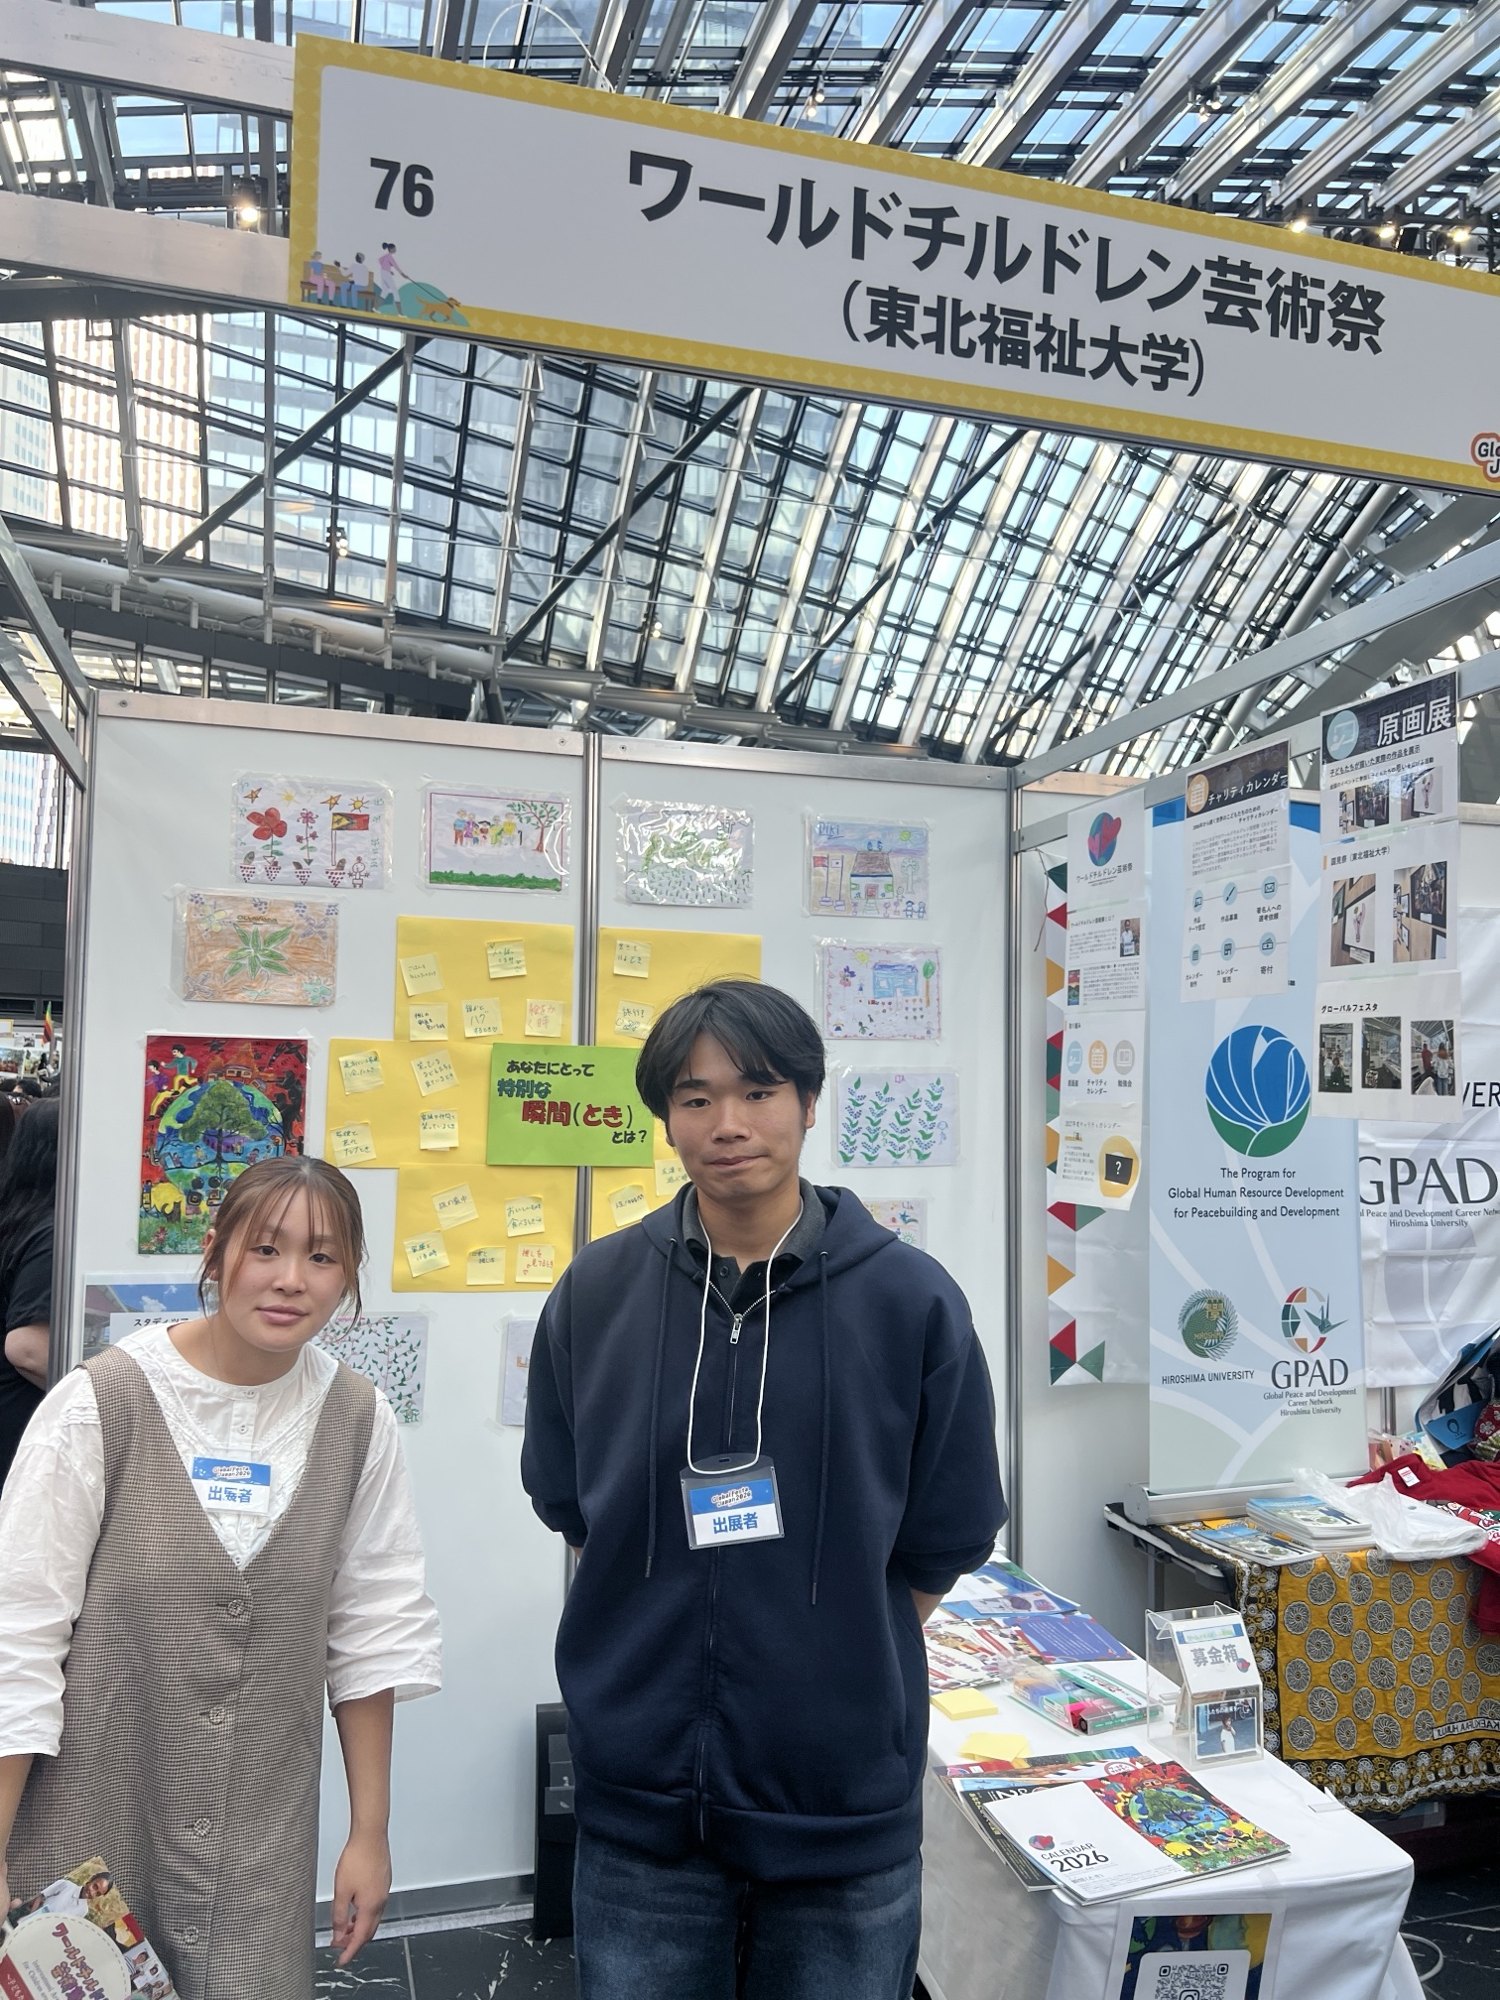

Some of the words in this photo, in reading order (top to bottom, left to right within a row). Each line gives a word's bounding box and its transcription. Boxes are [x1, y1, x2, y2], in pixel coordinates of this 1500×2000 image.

[370, 157, 434, 217] 76
[629, 150, 1386, 355] ワールドチルドレン芸術祭
[842, 280, 1204, 396] (東北福祉大学)
[1377, 696, 1452, 747] 原画展
[1208, 772, 1288, 805] チャリティカレンダー
[1216, 967, 1239, 976] カレンダー
[1260, 965, 1273, 975] 寄付
[1321, 1002, 1378, 1014] グローバルフェスタ
[506, 1059, 596, 1077] あなたにとって
[497, 1078, 552, 1099] 特別な
[522, 1100, 633, 1129] 瞬間(とき)
[611, 1129, 648, 1144] とは？
[1115, 1160, 1122, 1175] ?
[1220, 1167, 1239, 1178] The
[1241, 1167, 1280, 1181] Program
[1282, 1167, 1296, 1178] for
[1359, 1156, 1499, 1205] GPAD
[1168, 1187, 1201, 1199] Global
[1203, 1187, 1237, 1198] Human
[1239, 1186, 1283, 1198] Resource
[1285, 1186, 1344, 1200] Development
[1174, 1207, 1188, 1218] for
[1191, 1206, 1258, 1219] Peacebuilding
[1260, 1206, 1278, 1217] and
[1280, 1205, 1340, 1219] Development
[1366, 1209, 1387, 1218] Peace
[1389, 1209, 1403, 1217] and
[1404, 1209, 1453, 1221] Development
[1455, 1208, 1481, 1217] Career
[1389, 1219, 1429, 1228] Hiroshima
[1430, 1219, 1468, 1229] University
[1161, 1373, 1206, 1385] HIROSHIMA
[1208, 1370, 1255, 1382] UNIVERSITY
[1271, 1358, 1349, 1390] GPAD
[1263, 1391, 1284, 1400] Global
[1285, 1390, 1303, 1399] Peace
[1305, 1389, 1317, 1397] and
[1317, 1387, 1357, 1399] Development
[1287, 1399, 1308, 1407] Career
[1309, 1397, 1333, 1406] Network
[1280, 1407, 1311, 1416] Hiroshima
[1312, 1406, 1341, 1417] University
[207, 1485, 252, 1503] 出展者
[711, 1492, 731, 1503] Global
[713, 1511, 758, 1535] 出展者
[1190, 1643, 1240, 1668] 募金箱
[1041, 1842, 1096, 1861] CALENDAR
[1050, 1850, 1110, 1873] 2026
